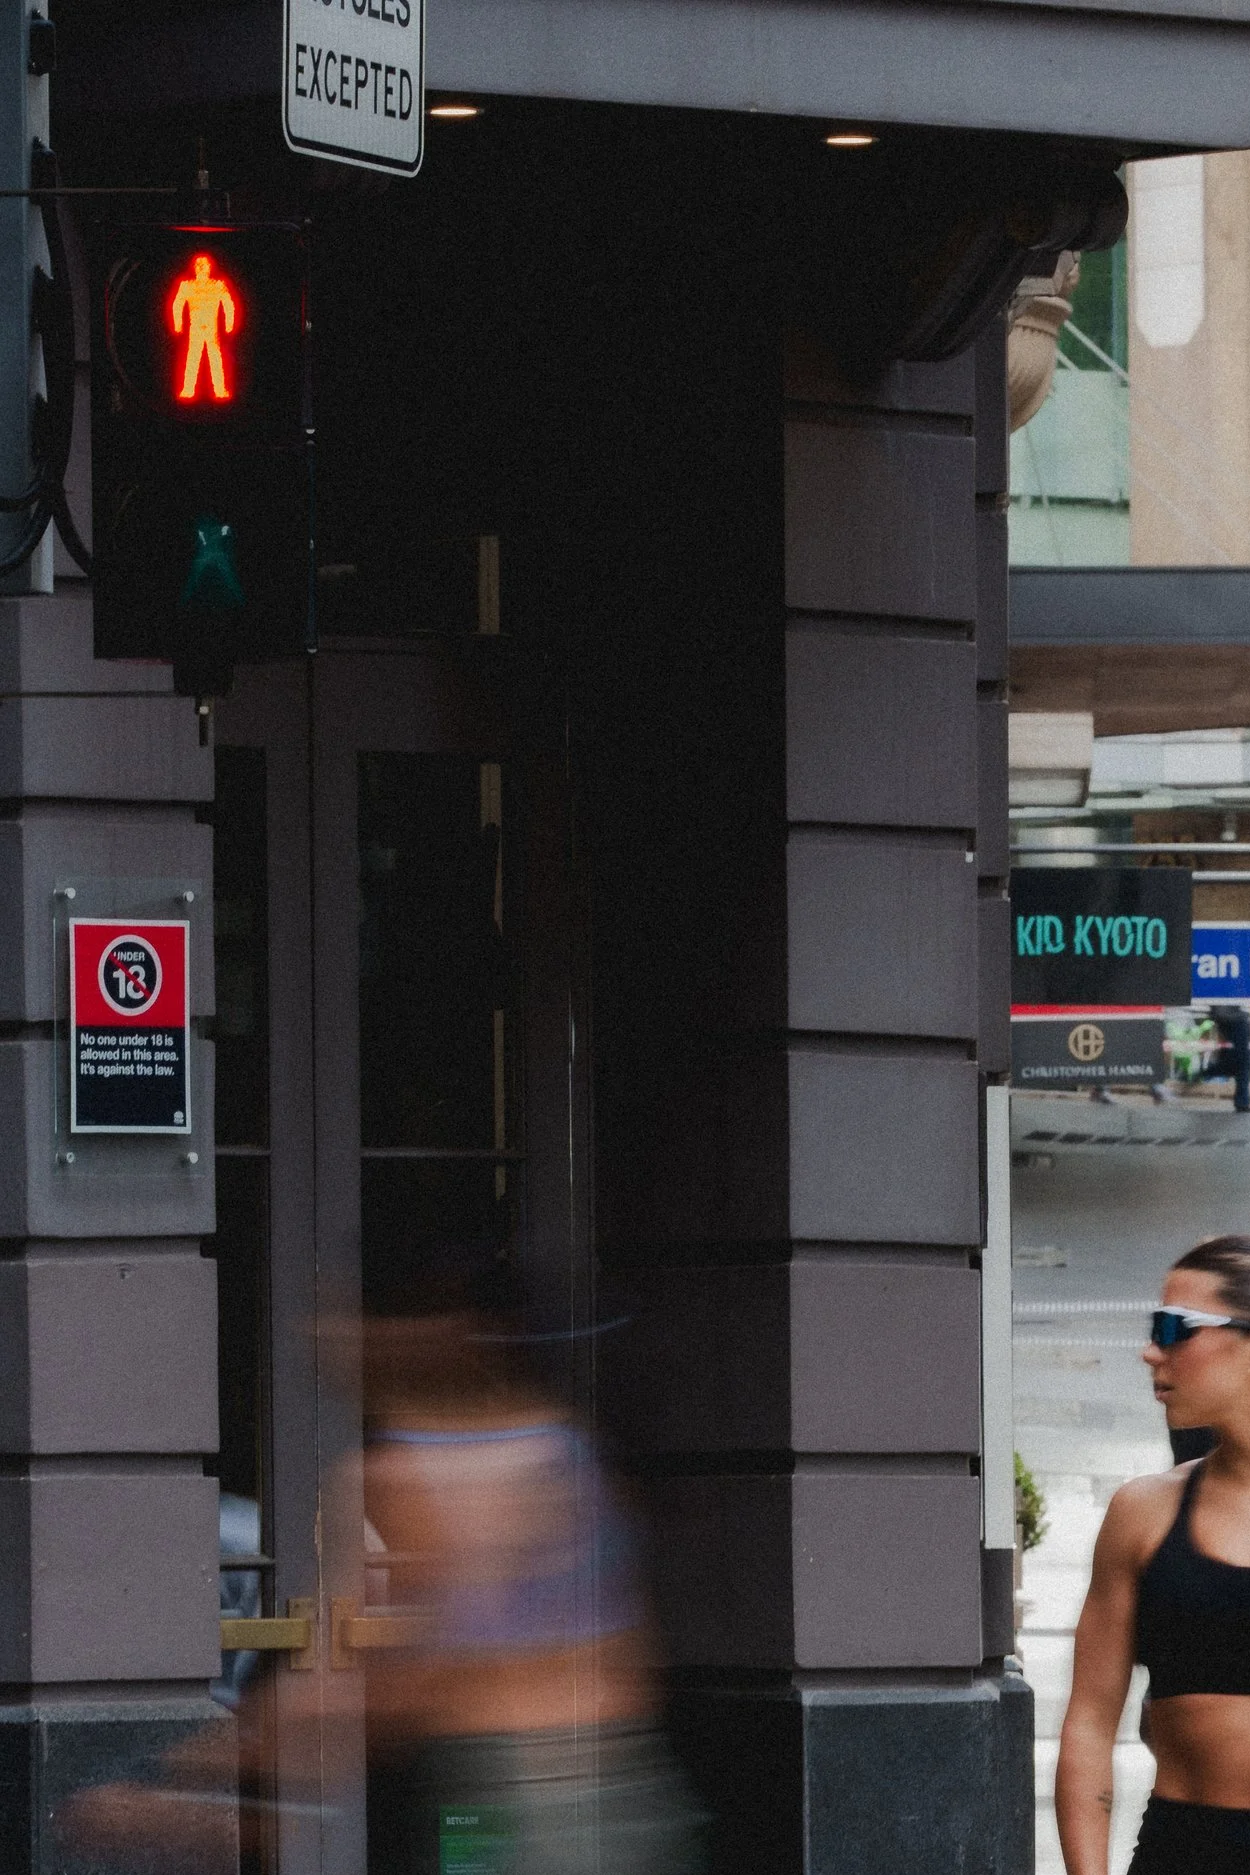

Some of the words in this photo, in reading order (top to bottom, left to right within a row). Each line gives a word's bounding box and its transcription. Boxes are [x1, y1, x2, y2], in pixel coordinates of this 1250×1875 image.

[296, 43, 412, 120] EXCEPTED
[1016, 914, 1065, 956] KID
[1073, 914, 1168, 959] KYOTO
[112, 964, 147, 999] 18
[80, 1033, 95, 1045] No
[97, 1035, 116, 1045] one
[119, 1034, 148, 1046] under
[151, 1034, 163, 1046] 18
[164, 1034, 174, 1046] is
[80, 1048, 120, 1060] allowed
[122, 1049, 131, 1060] in
[133, 1049, 152, 1061] this
[154, 1051, 179, 1061] area.
[80, 1062, 95, 1075] It's
[97, 1063, 135, 1077] against
[136, 1063, 153, 1076] the
[155, 1064, 175, 1076] law.
[1021, 1064, 1106, 1078] CHRISTOPHER
